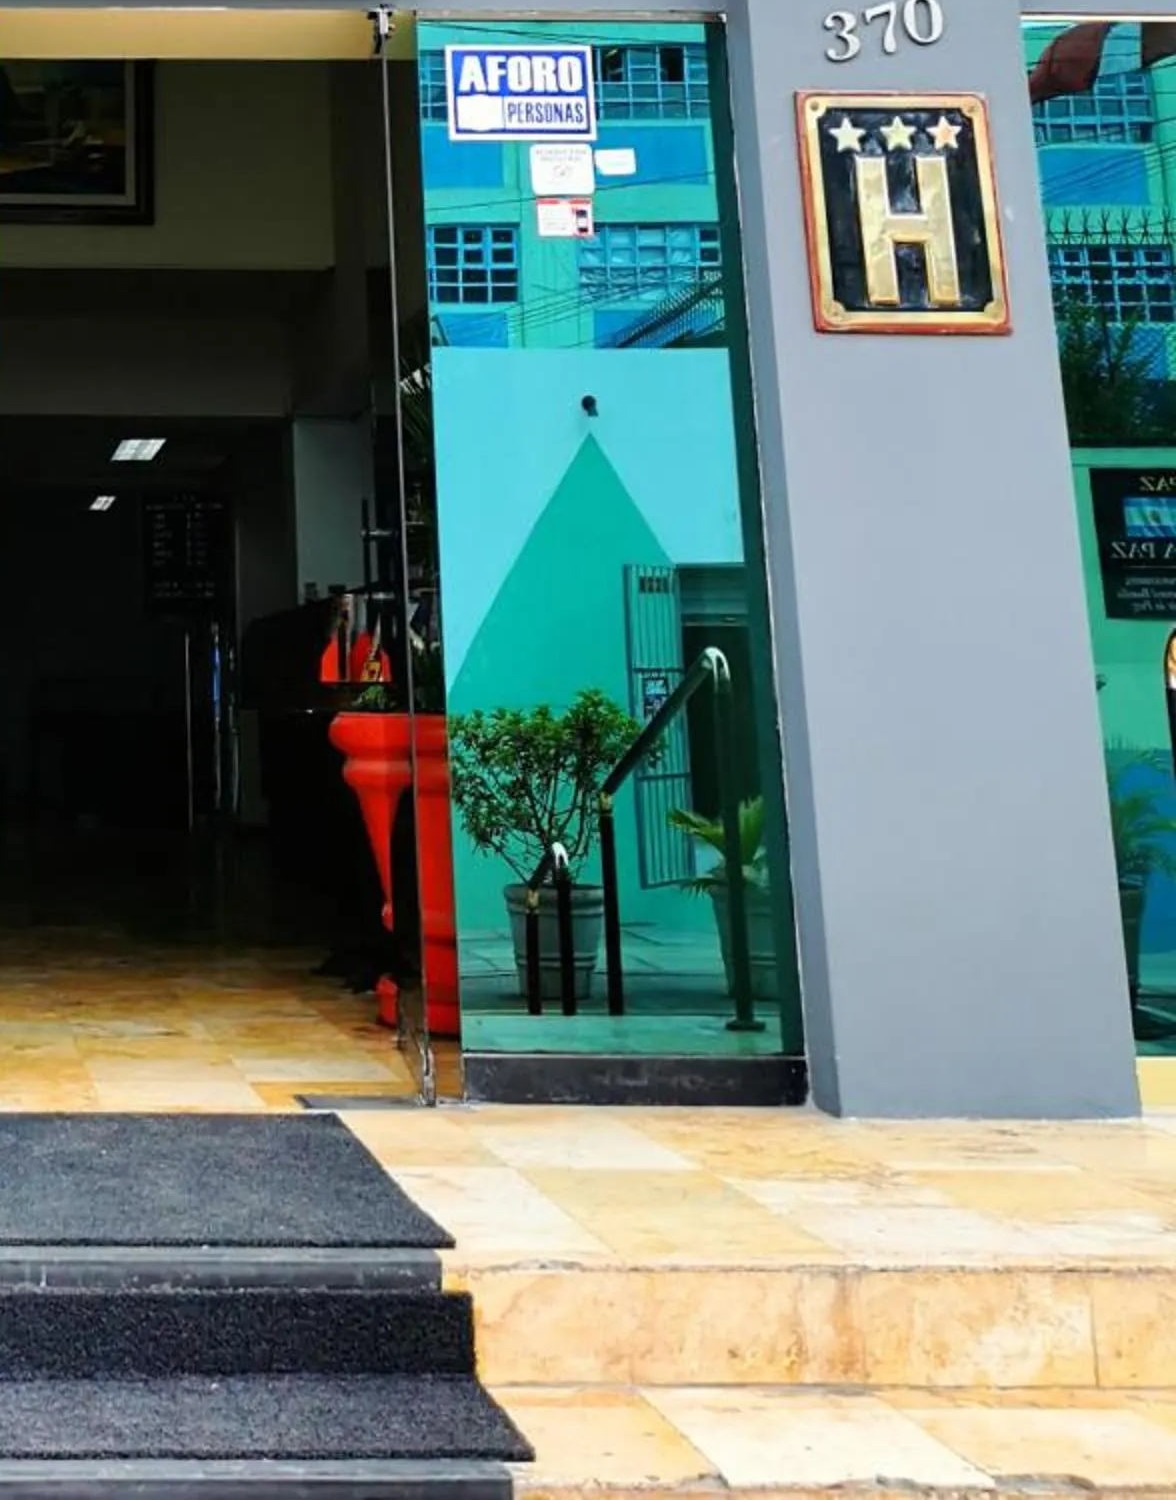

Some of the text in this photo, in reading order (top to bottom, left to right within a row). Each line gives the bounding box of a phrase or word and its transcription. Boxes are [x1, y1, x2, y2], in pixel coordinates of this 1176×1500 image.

[458, 55, 584, 93] AFORO
[507, 102, 585, 124] PERSONAS
[854, 156, 960, 306] H
